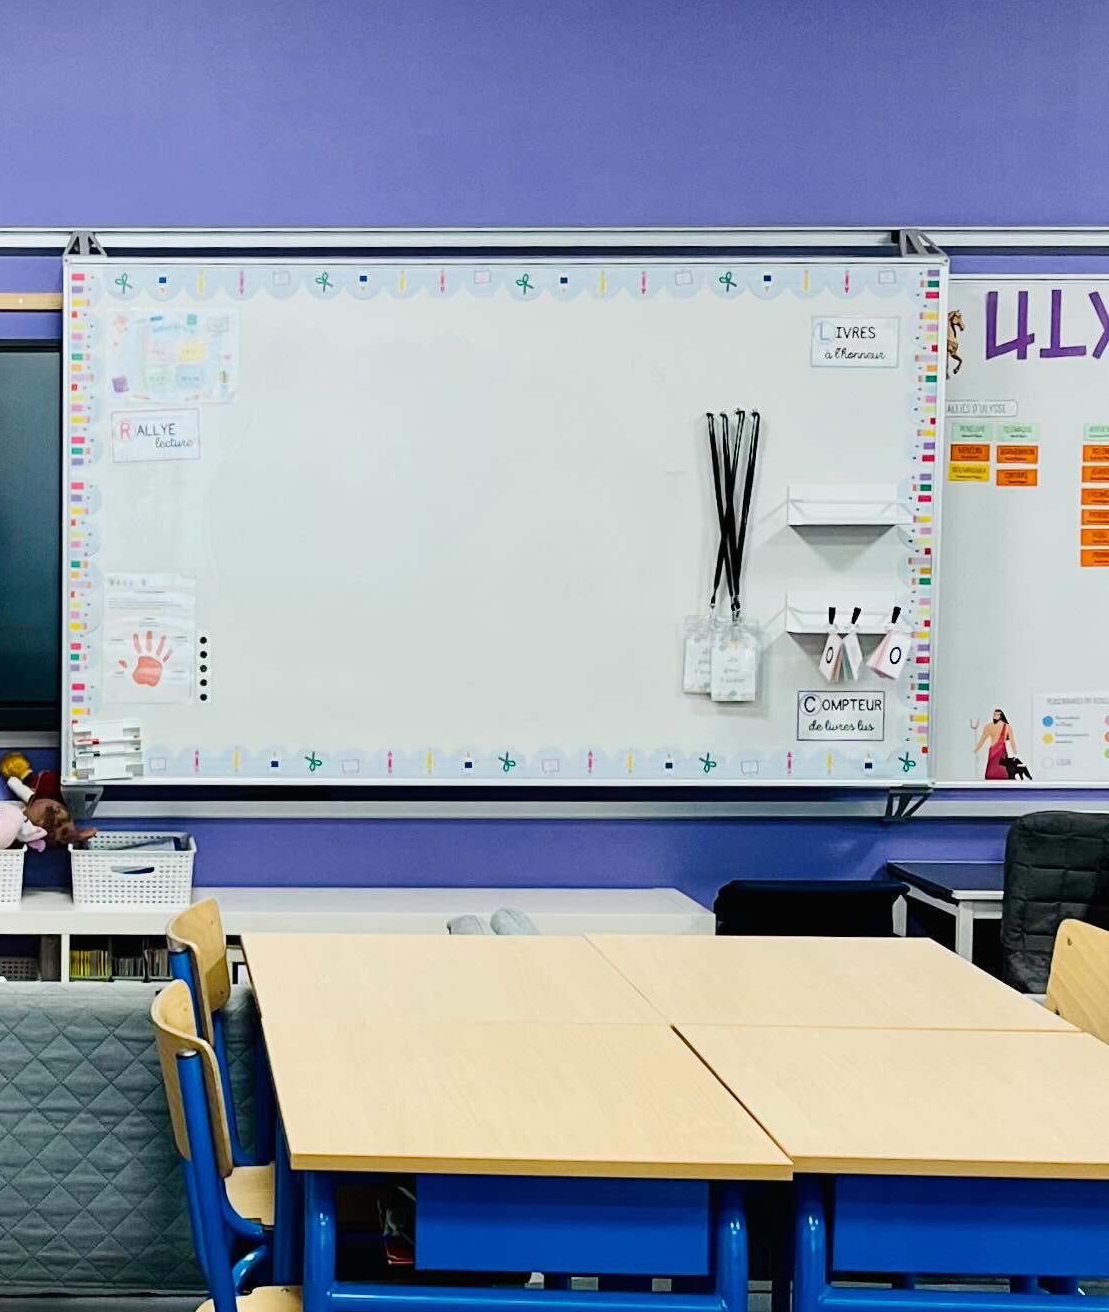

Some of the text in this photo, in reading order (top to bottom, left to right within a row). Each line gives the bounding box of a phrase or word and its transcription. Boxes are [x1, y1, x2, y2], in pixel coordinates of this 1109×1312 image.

[819, 324, 876, 340] LIVRES
[120, 422, 176, 440] RALLYE
[803, 696, 882, 713] COMPTEUR
[808, 719, 875, 732] de livres lus
